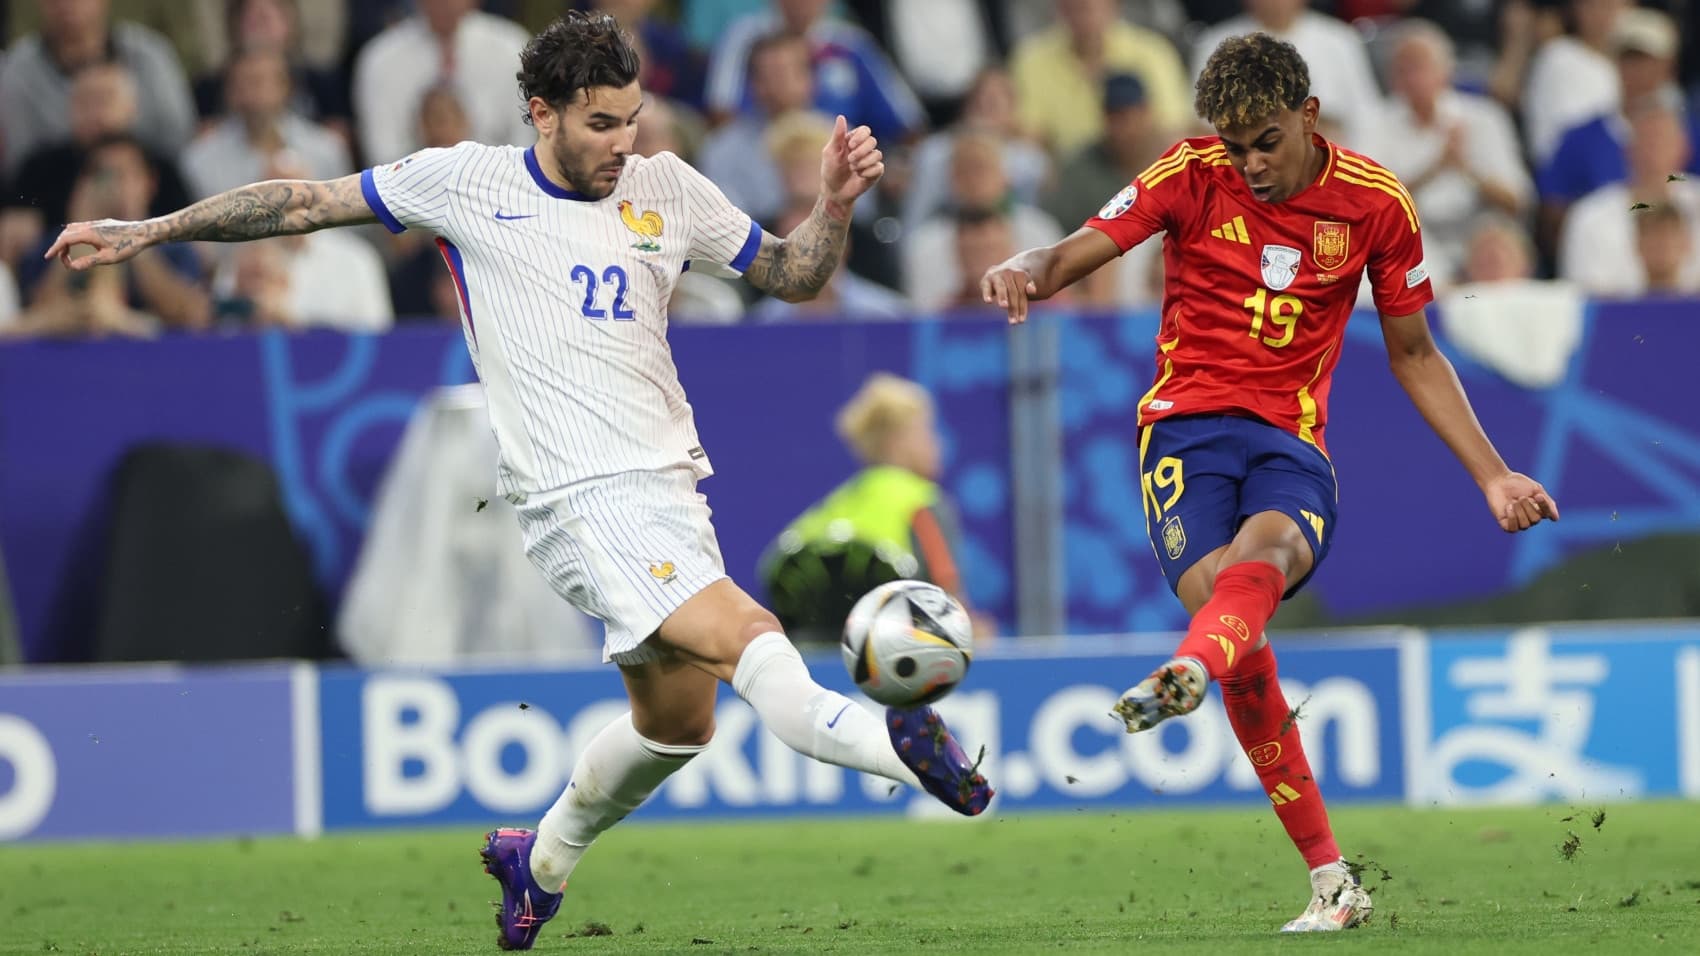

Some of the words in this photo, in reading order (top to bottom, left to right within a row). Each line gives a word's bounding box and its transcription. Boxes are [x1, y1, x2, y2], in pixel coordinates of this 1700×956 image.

[570, 264, 635, 321] 22
[1243, 288, 1304, 348] 19
[1144, 456, 1185, 523] 19
[362, 675, 1380, 822] Boki.com
